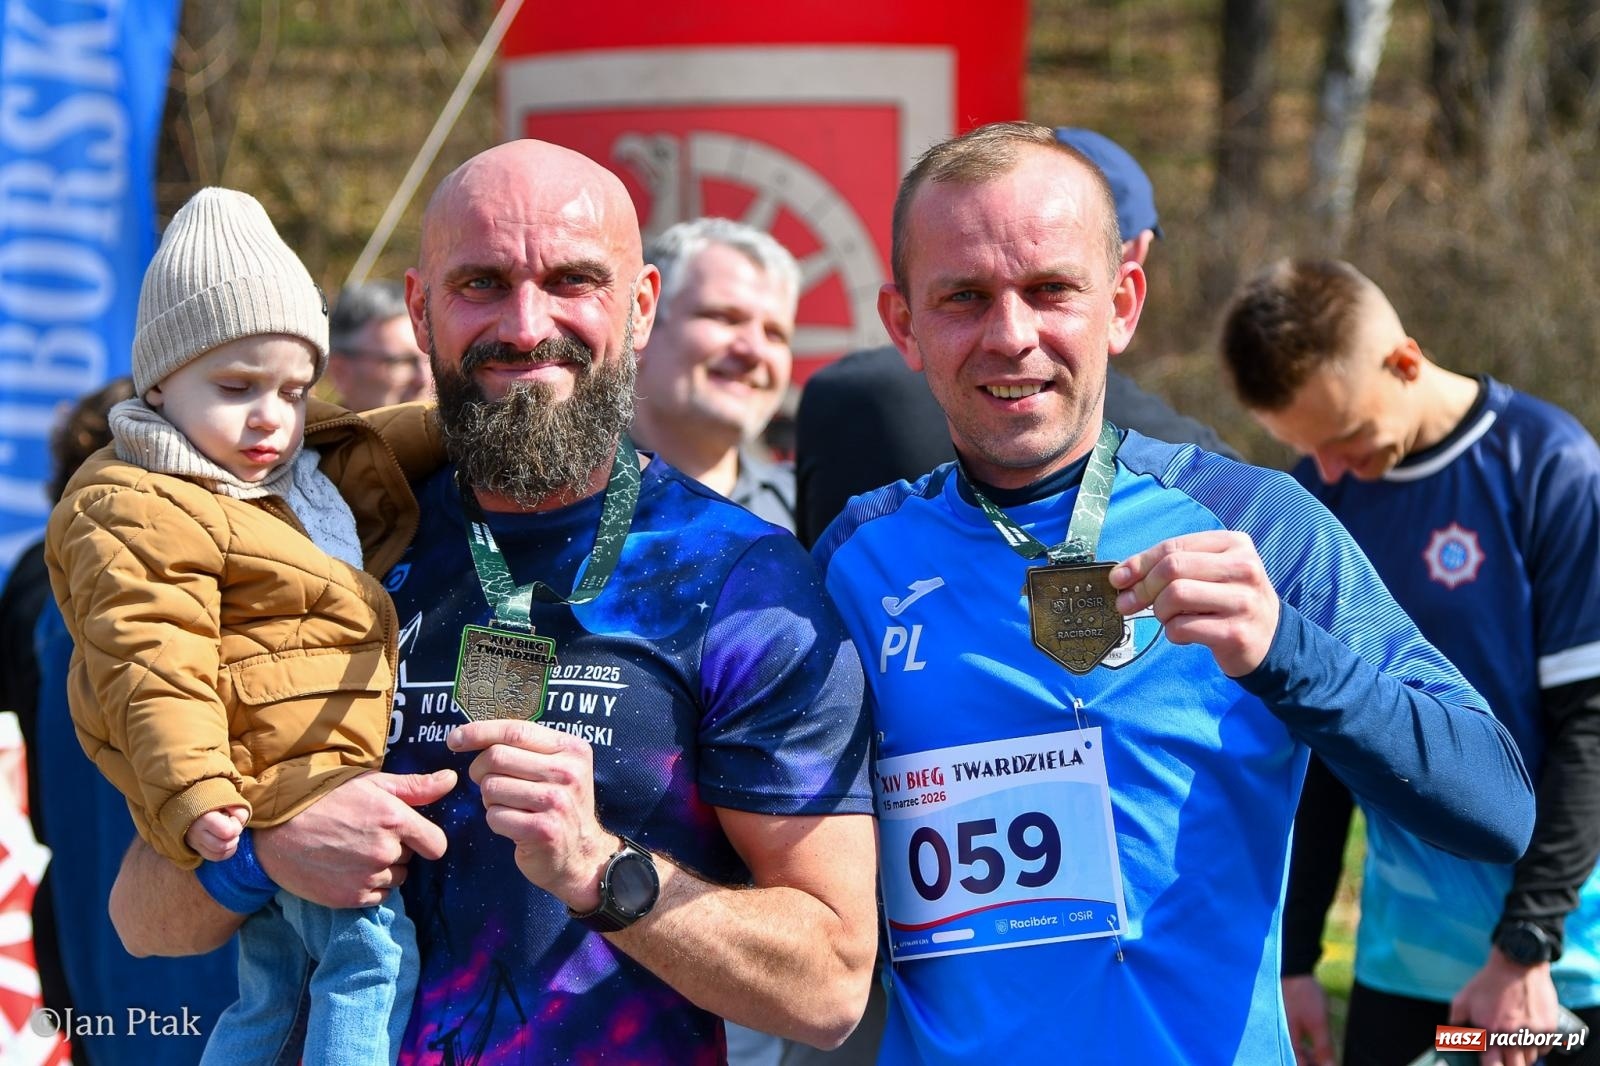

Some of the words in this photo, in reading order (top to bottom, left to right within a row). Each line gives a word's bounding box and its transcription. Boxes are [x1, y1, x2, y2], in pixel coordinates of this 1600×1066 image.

[1077, 597, 1103, 608] OSiR
[475, 643, 558, 665] TWARDZIELA
[490, 635, 513, 646] XIV
[516, 640, 544, 651] BIEG
[880, 624, 927, 673] PL
[547, 691, 617, 717] TOWY
[880, 773, 901, 794] XIV
[906, 766, 945, 790] BIEG
[952, 748, 1084, 783] TWARDZIELA
[884, 800, 892, 811] 15
[893, 798, 920, 810] marzec
[921, 791, 947, 805] 2026
[908, 811, 1062, 902] 059
[1010, 914, 1058, 930] Racibórz
[1068, 911, 1093, 923] OSiR
